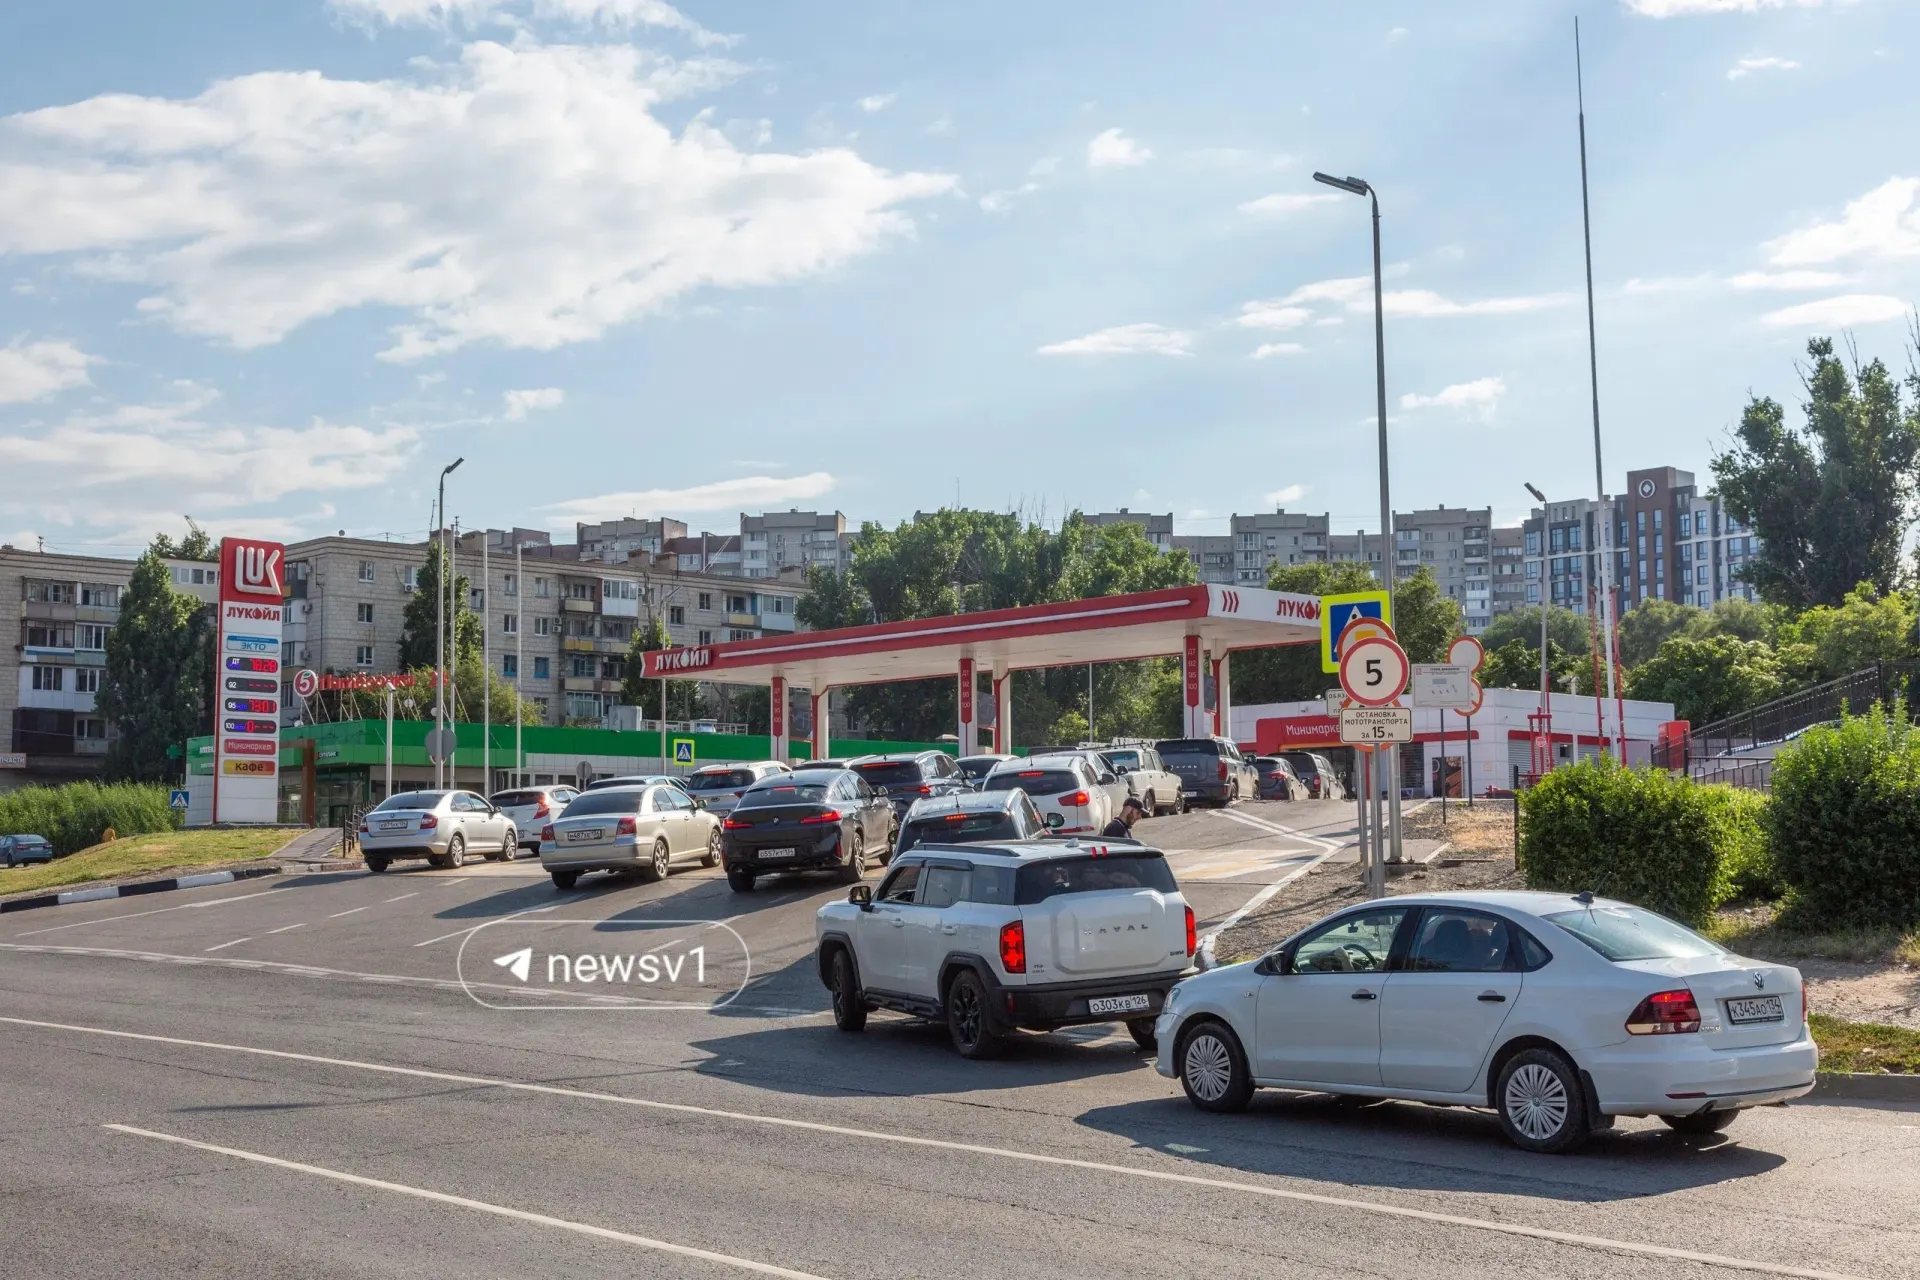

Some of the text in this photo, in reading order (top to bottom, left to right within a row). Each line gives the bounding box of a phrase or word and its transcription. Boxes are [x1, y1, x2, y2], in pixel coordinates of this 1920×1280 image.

[226, 606, 280, 621] ЛУКОЙЛ
[241, 642, 266, 651] ЭКТО
[654, 646, 711, 671] ЛУКОЙЛ
[1365, 659, 1383, 686] 5
[228, 681, 237, 689] 92
[228, 701, 236, 709] 95
[225, 723, 235, 731] 100
[1372, 726, 1385, 738] 15
[1092, 998, 1132, 1012] О303КВ
[1132, 995, 1147, 1005] 126
[1731, 998, 1781, 1018] К345АО 134
